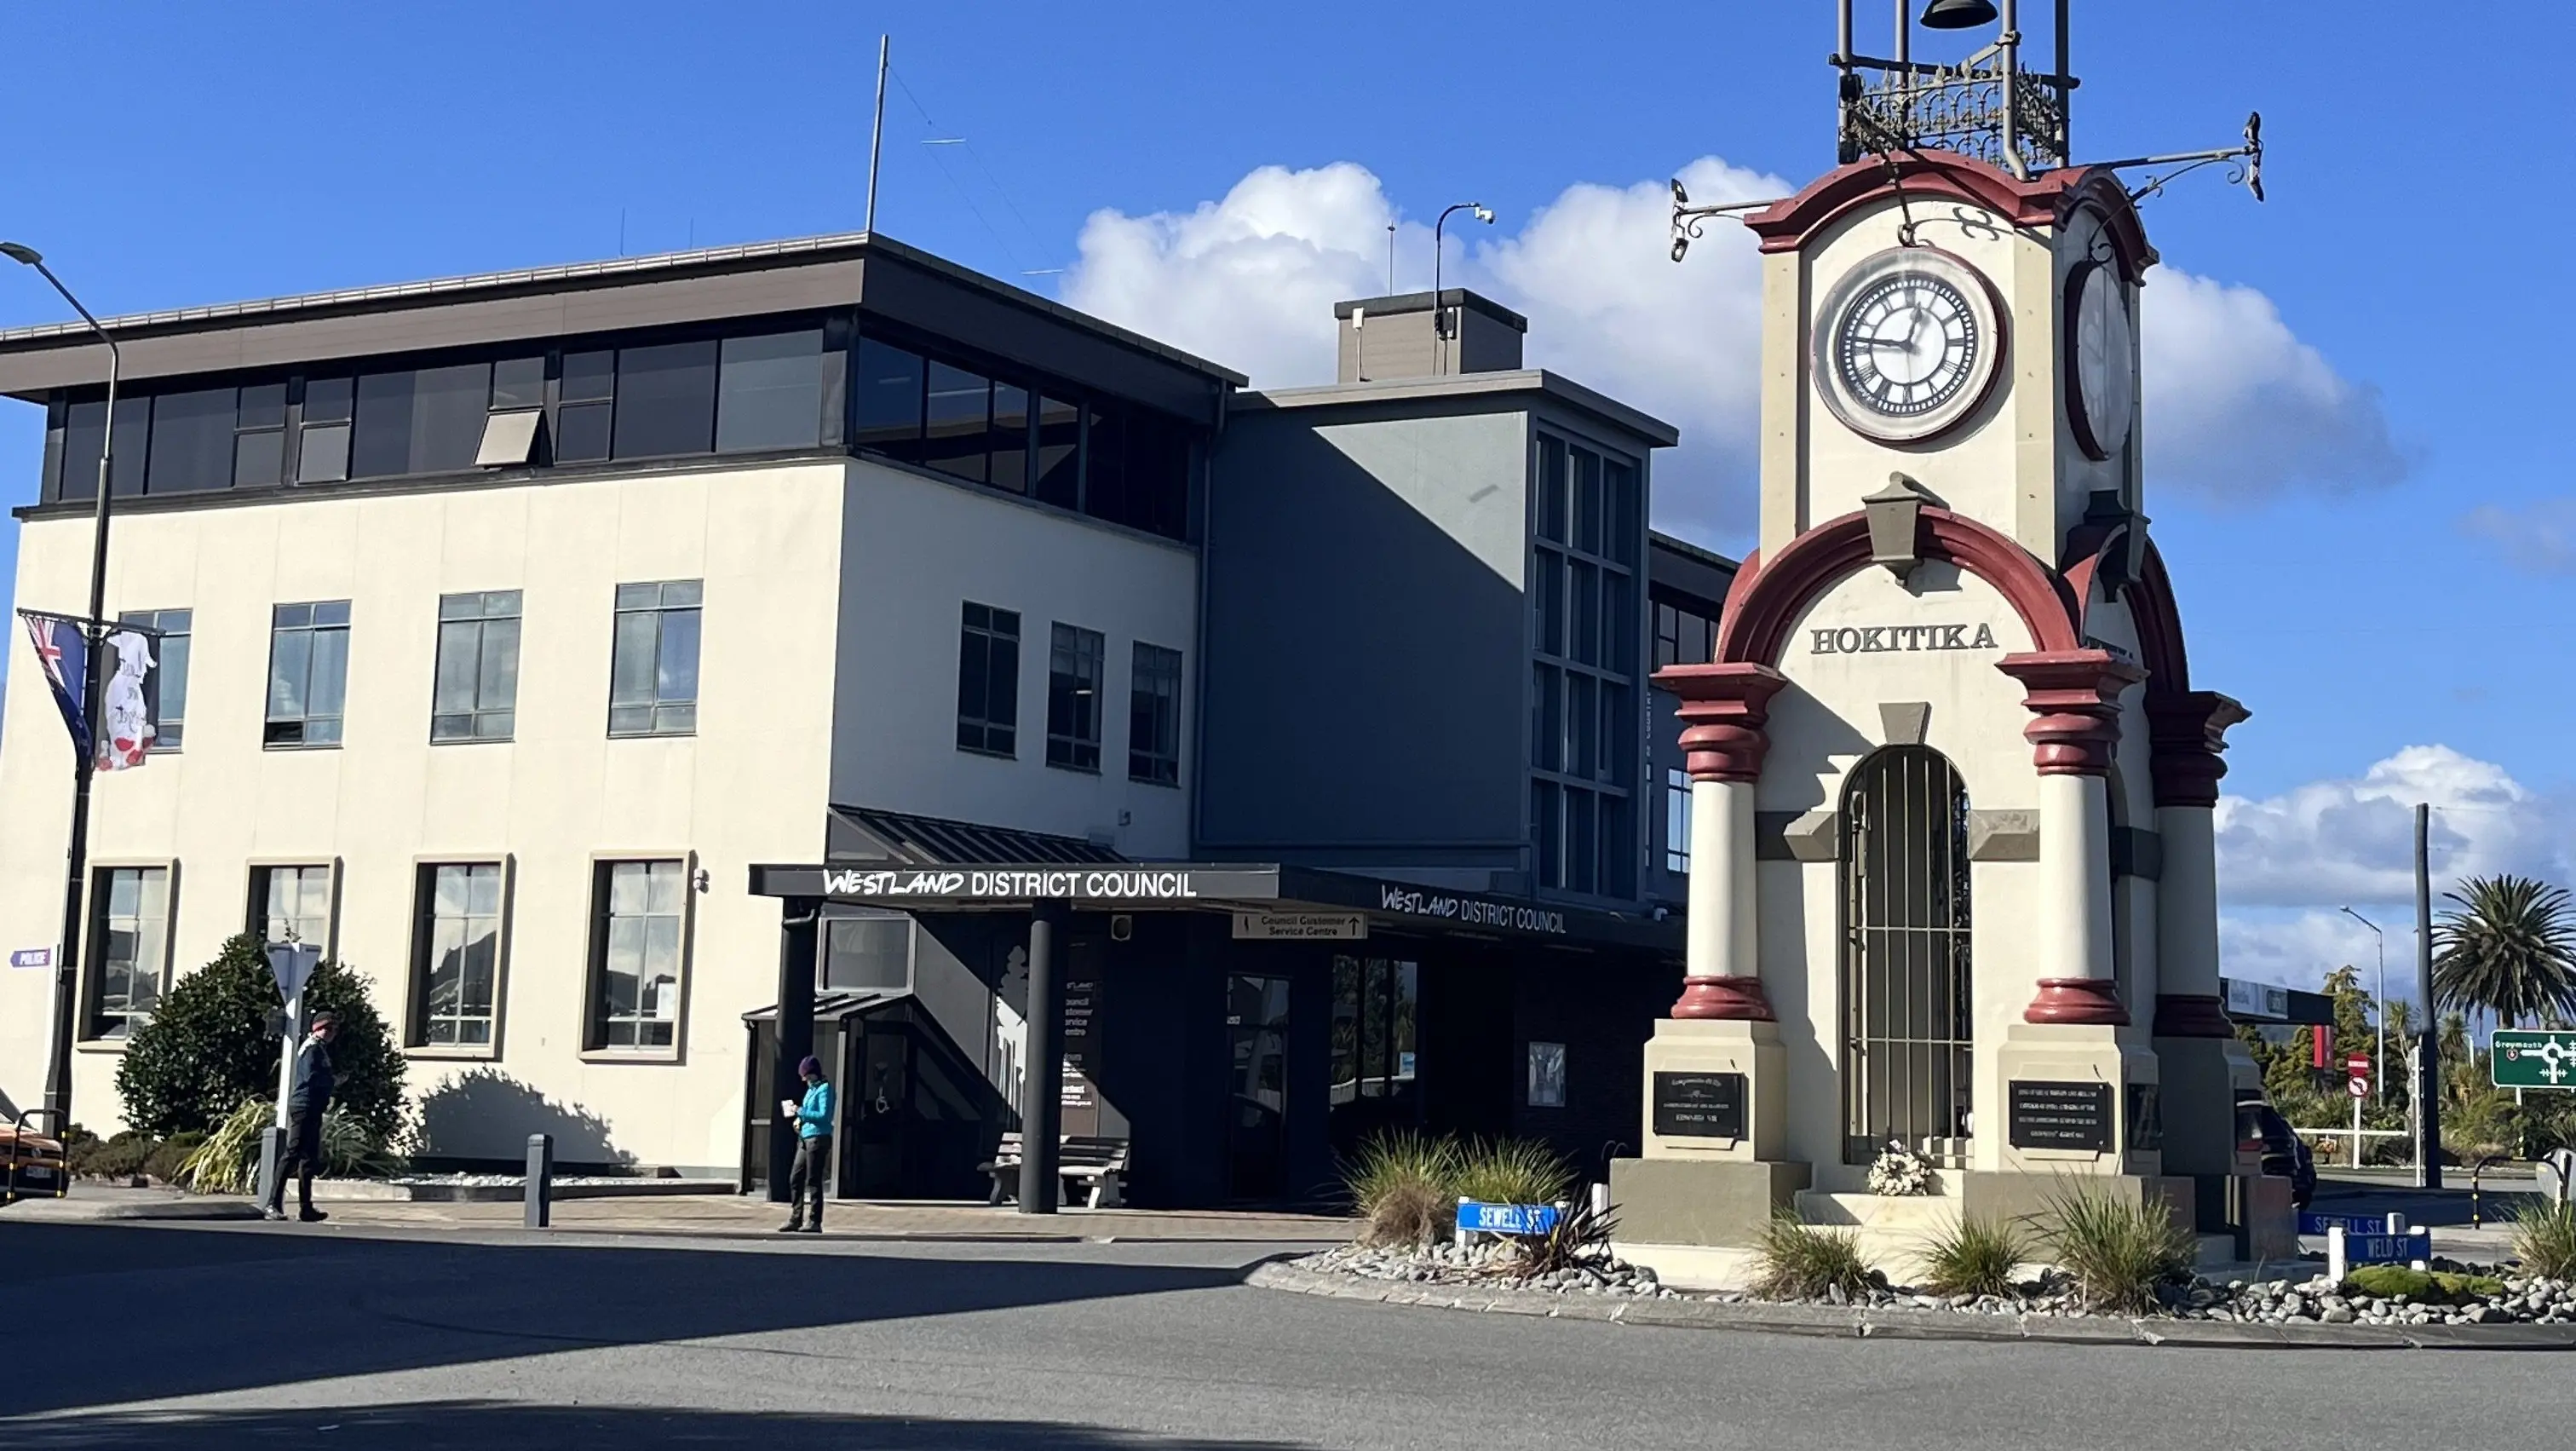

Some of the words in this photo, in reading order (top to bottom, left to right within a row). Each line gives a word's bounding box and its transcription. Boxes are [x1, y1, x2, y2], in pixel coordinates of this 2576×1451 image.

[1809, 622, 1999, 654] HOKITIKA
[823, 869, 964, 895] WESTLAND
[971, 872, 1081, 896] DISTRICT
[1085, 872, 1197, 897] COUNCIL
[1381, 884, 1458, 918] WESTLAND
[1461, 899, 1515, 927] DISTRICT
[1516, 907, 1567, 934] COUNCIL
[1261, 916, 1297, 925] Council
[1299, 916, 1346, 926] Customer
[1268, 926, 1303, 936] Service
[1306, 926, 1337, 936] Centre
[20, 951, 46, 965] POLICE
[1478, 1206, 1521, 1228] SEWELL
[2314, 1216, 2360, 1235] SELL
[2366, 1219, 2382, 1235] ST
[2366, 1238, 2394, 1258] WELD
[2396, 1237, 2409, 1258] ST
